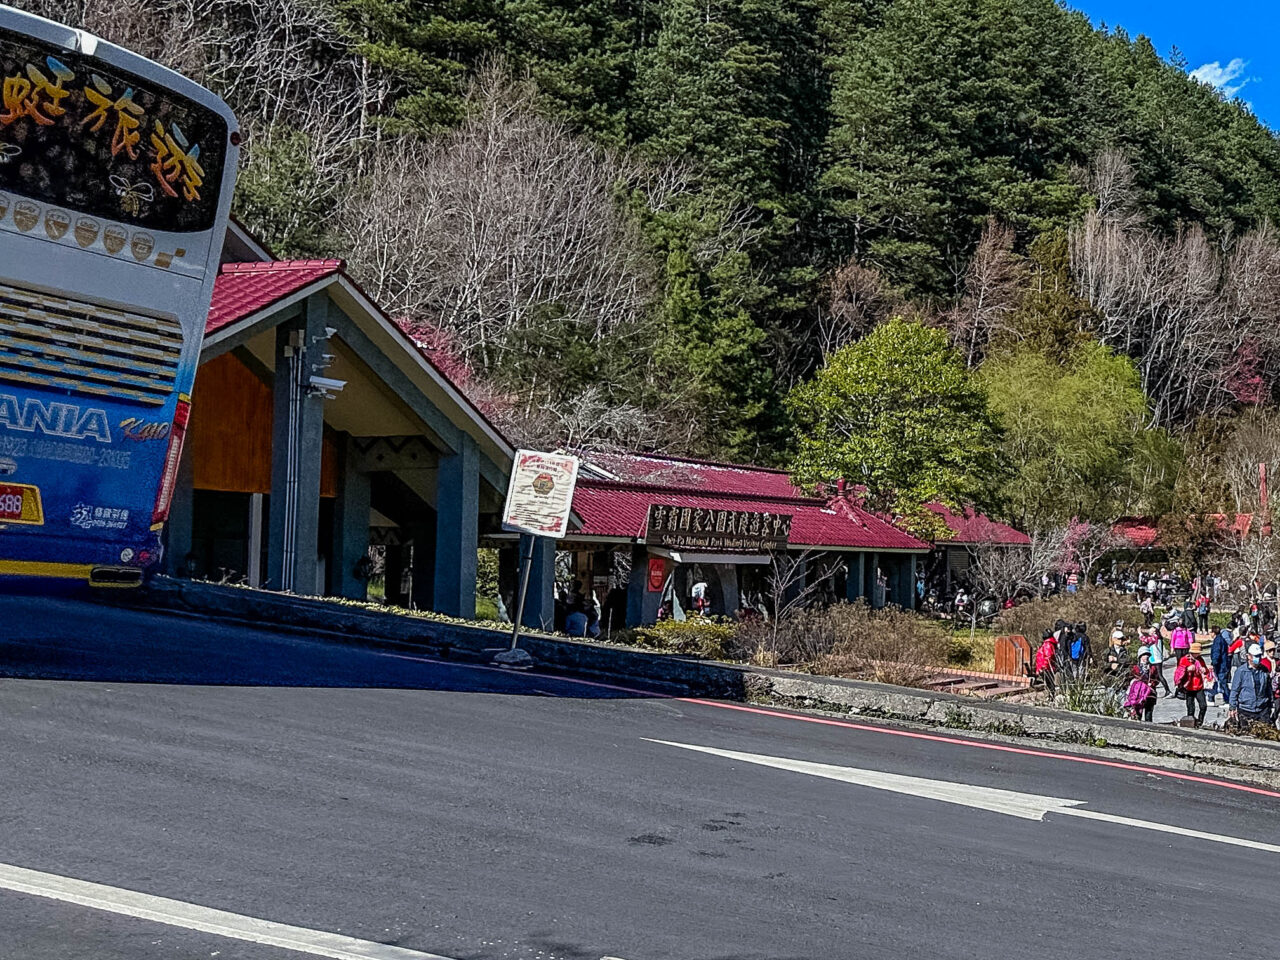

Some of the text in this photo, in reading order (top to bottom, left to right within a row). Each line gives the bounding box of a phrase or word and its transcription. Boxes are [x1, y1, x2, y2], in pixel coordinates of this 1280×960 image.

[654, 506, 791, 537] 雪霸國家公園武陵遊客中心
[711, 537, 722, 546] Park
